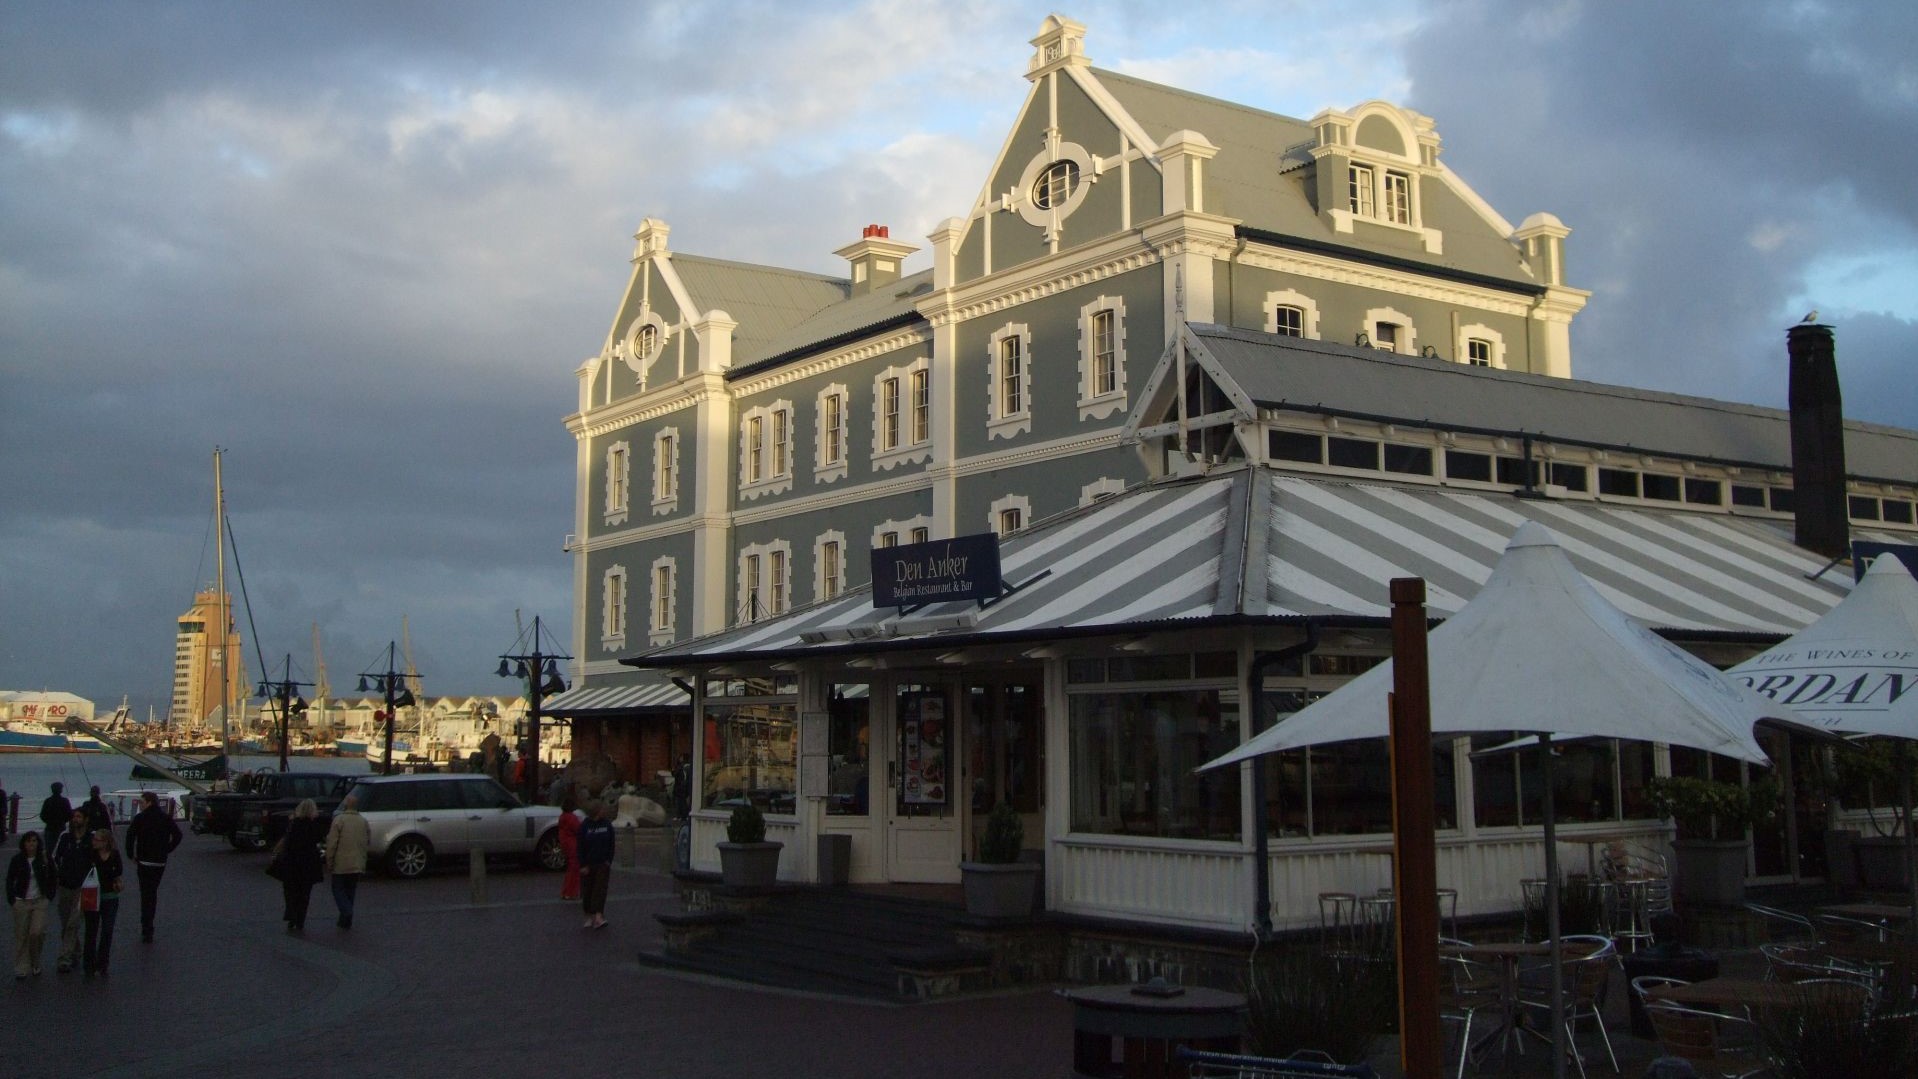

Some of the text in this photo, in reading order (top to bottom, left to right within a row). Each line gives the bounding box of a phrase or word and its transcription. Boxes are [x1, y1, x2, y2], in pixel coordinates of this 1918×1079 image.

[896, 543, 968, 582] Den Anker
[894, 580, 973, 600] Belgian Restaurant & Bar
[1757, 650, 1914, 664] THE WINES OF
